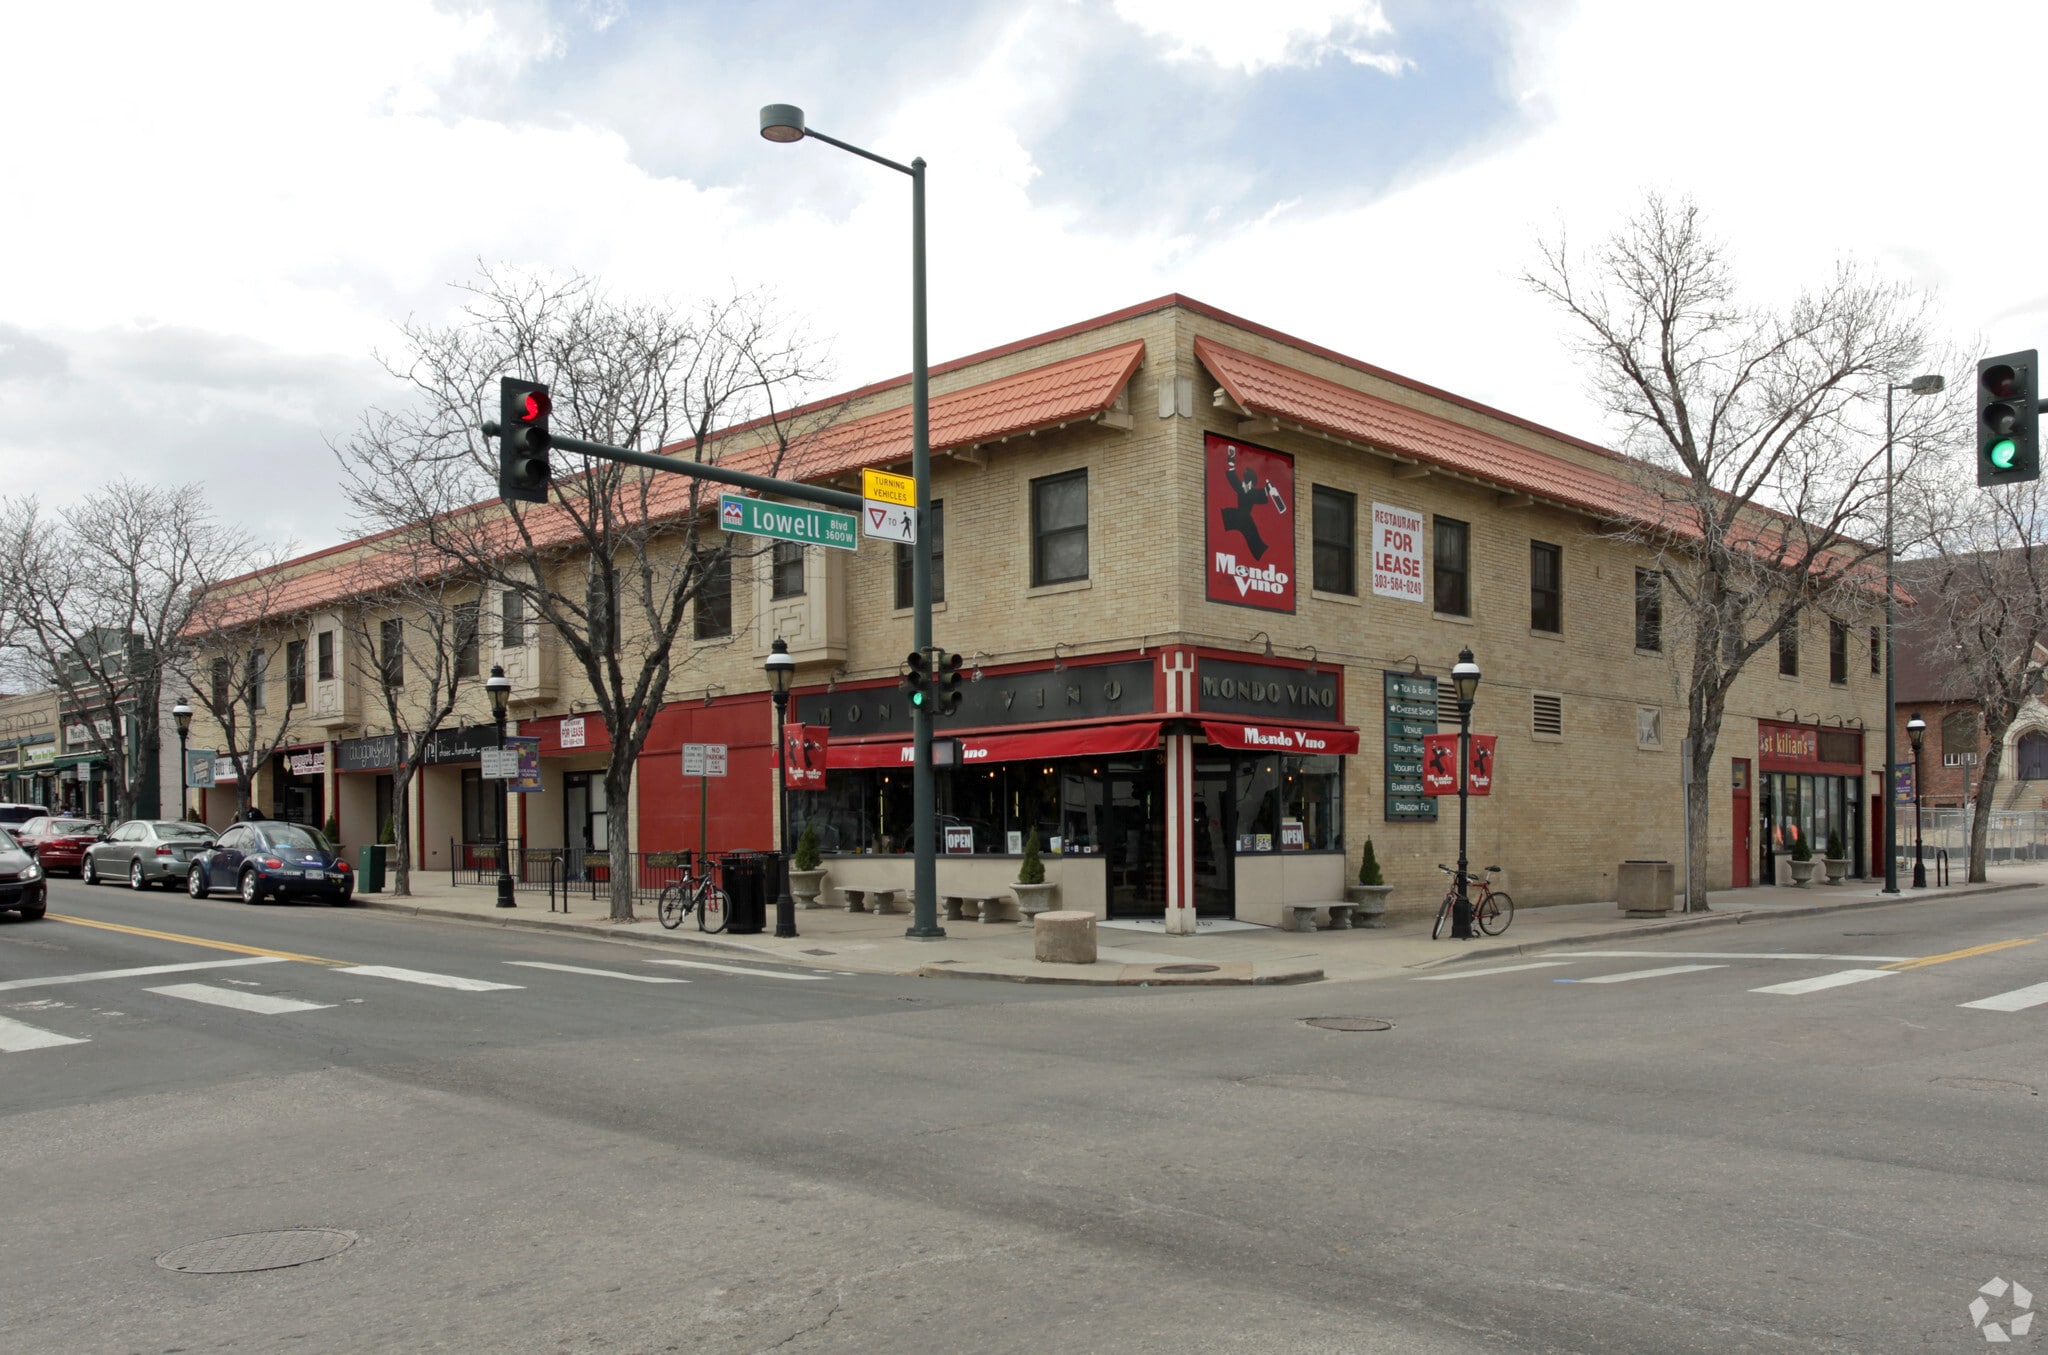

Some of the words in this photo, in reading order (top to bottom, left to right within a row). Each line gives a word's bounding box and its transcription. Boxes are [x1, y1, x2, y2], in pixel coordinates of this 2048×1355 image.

[874, 476, 905, 490] TURNING
[873, 487, 908, 502] VEHICLES
[752, 506, 820, 539] Lowell
[830, 519, 848, 532] Blvd
[887, 517, 897, 527] TO
[1375, 509, 1421, 532] RESTAURANT
[1384, 528, 1413, 553] FOR
[1215, 551, 1289, 584] Mondo
[1375, 551, 1421, 579] LEASE
[1233, 575, 1284, 598] Vino
[1000, 679, 1123, 711] VINO
[1202, 676, 1281, 704] MONDO
[1287, 684, 1335, 709] VINO
[1401, 683, 1412, 693] TEA
[1418, 687, 1432, 696] BIKE
[1396, 704, 1419, 716] CHEESE
[1419, 708, 1435, 716] SHOP
[561, 727, 570, 738] FOR
[571, 727, 584, 737] LEASE
[1244, 727, 1293, 747] Mondo
[1403, 724, 1423, 735] VENUE
[711, 746, 721, 754] NO
[1393, 743, 1412, 754] STRUT
[1764, 736, 1774, 752] st
[1393, 763, 1415, 773] YOGURT
[1395, 803, 1420, 812] DRAGON
[1420, 804, 1431, 812] FLY
[948, 833, 971, 849] OPEN
[1282, 829, 1303, 845] OPEN
